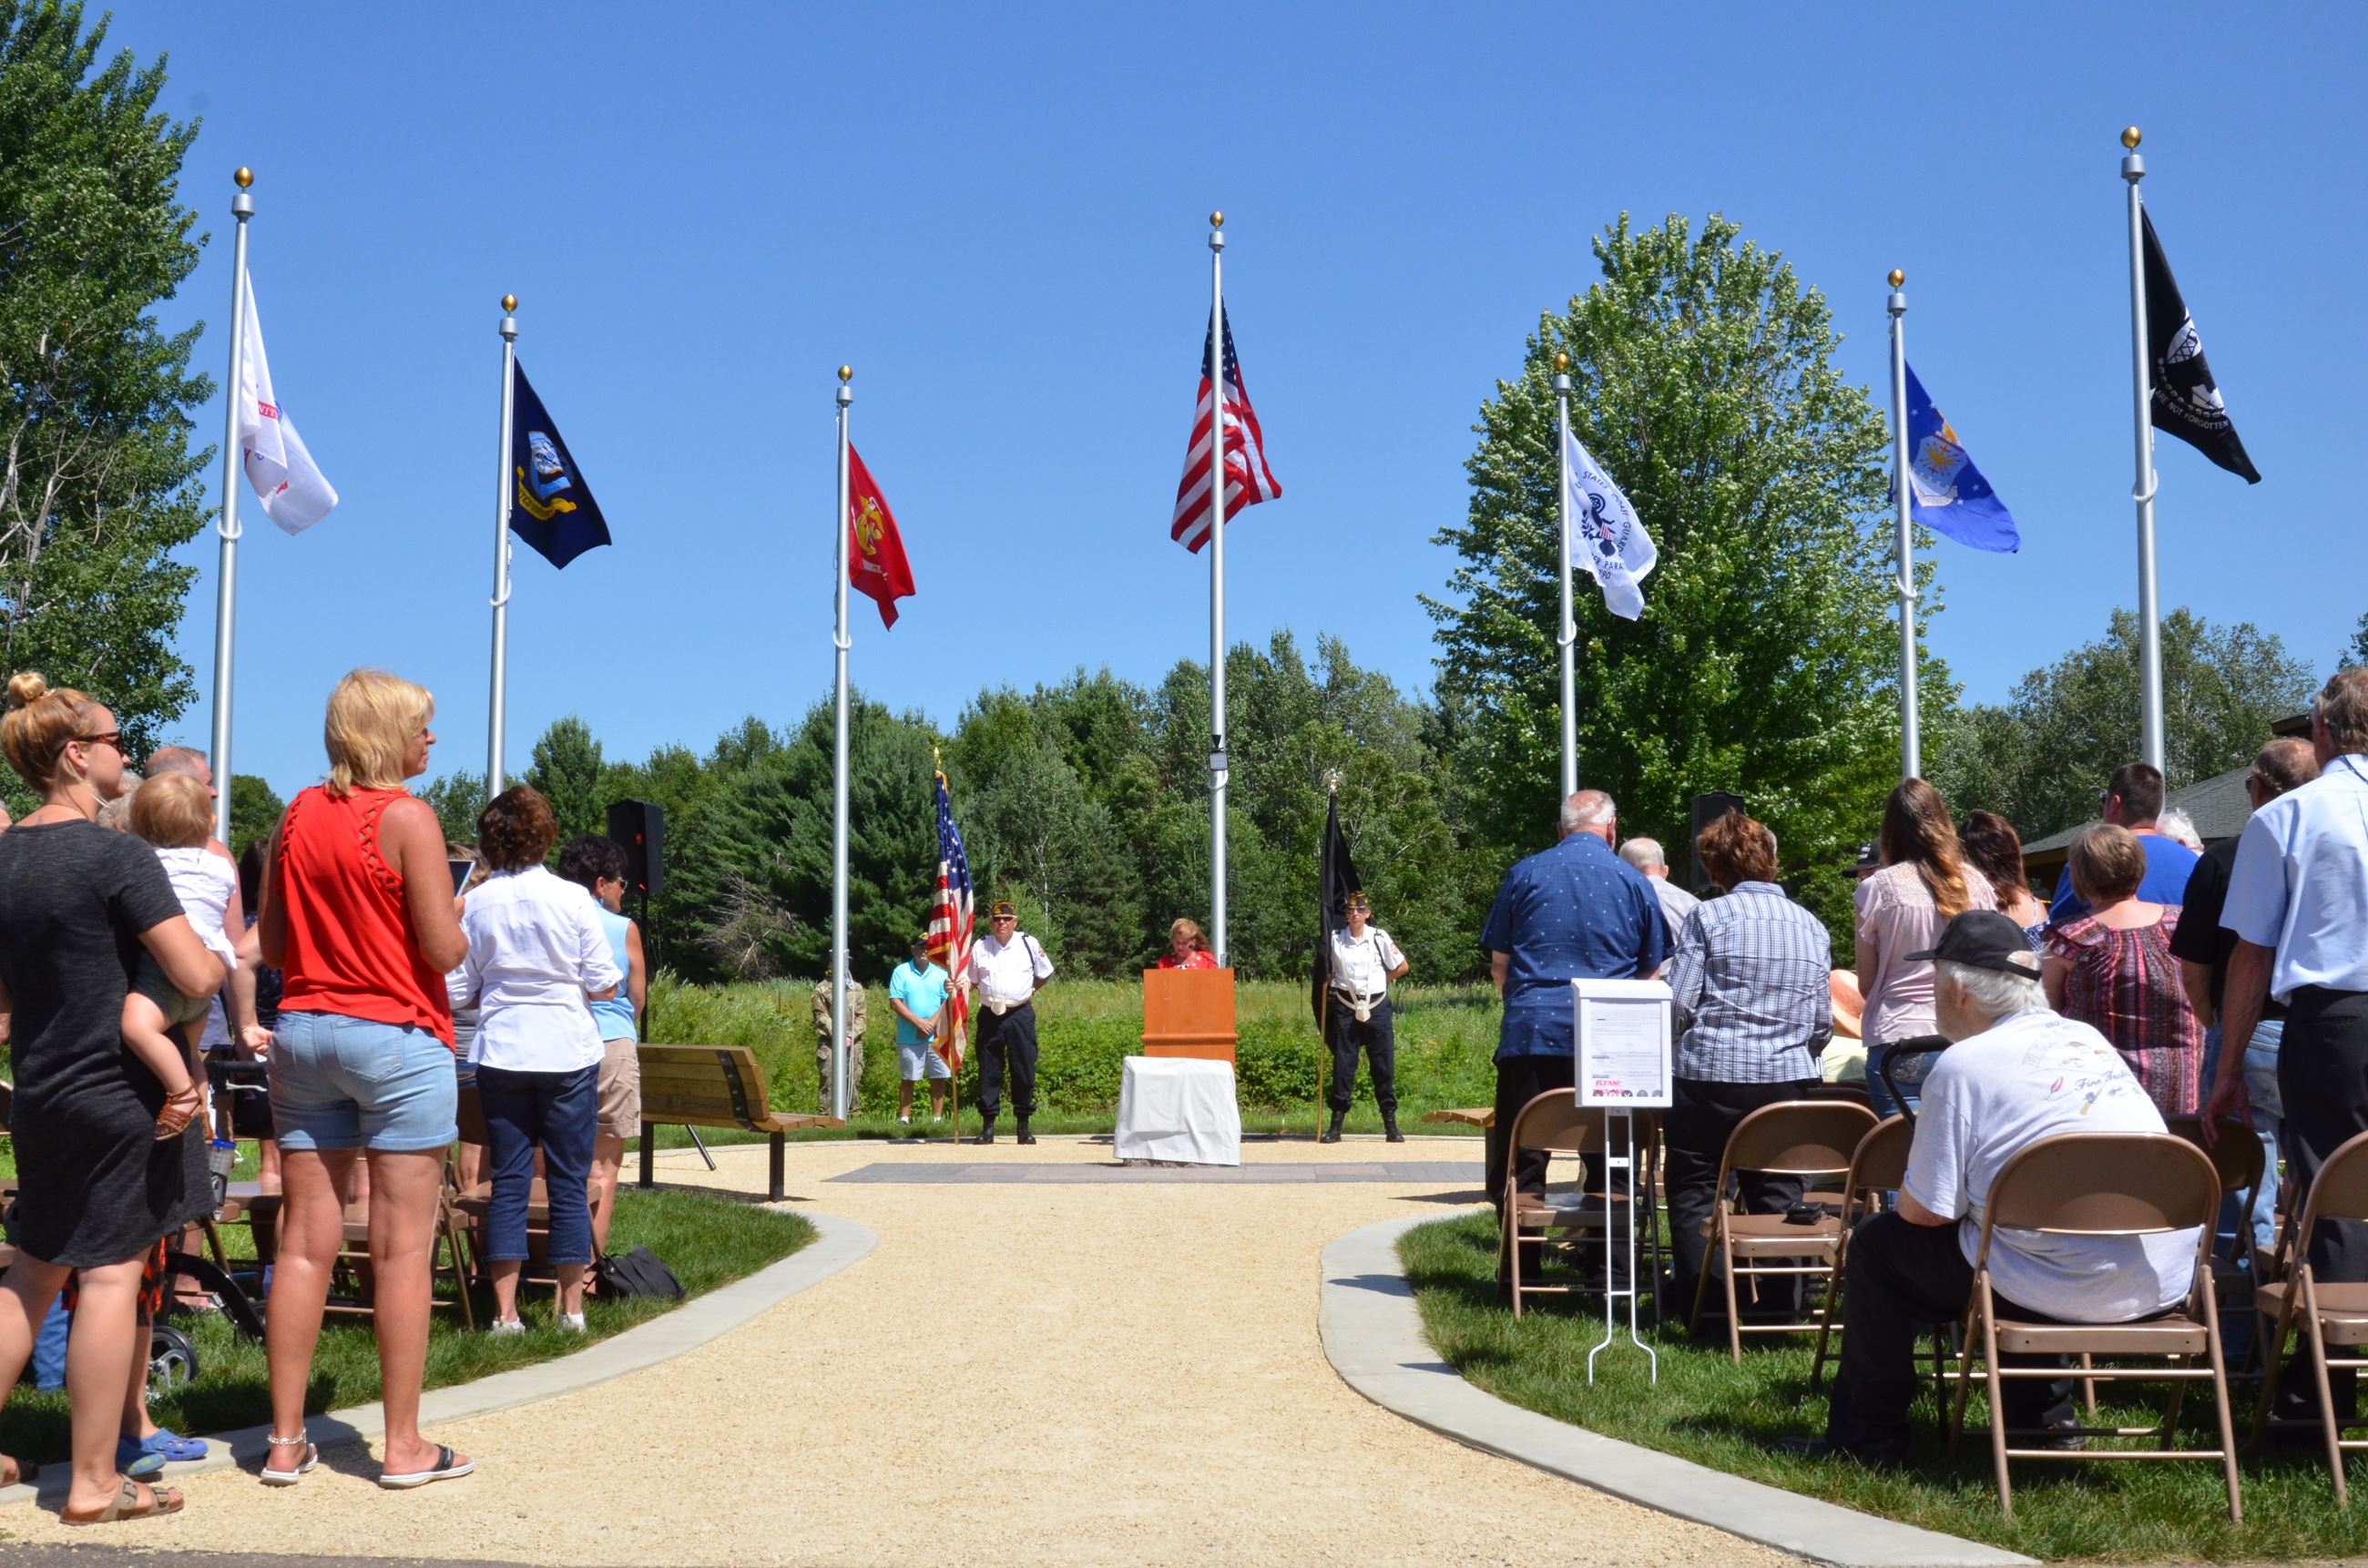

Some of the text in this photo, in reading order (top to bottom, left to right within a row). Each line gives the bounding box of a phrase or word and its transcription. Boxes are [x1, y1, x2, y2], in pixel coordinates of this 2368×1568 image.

[2155, 389, 2229, 430] ARE NOT FORGOTTEN
[1582, 471, 1631, 553] STATES COAST GUARD
[1597, 568, 1611, 580] 790
